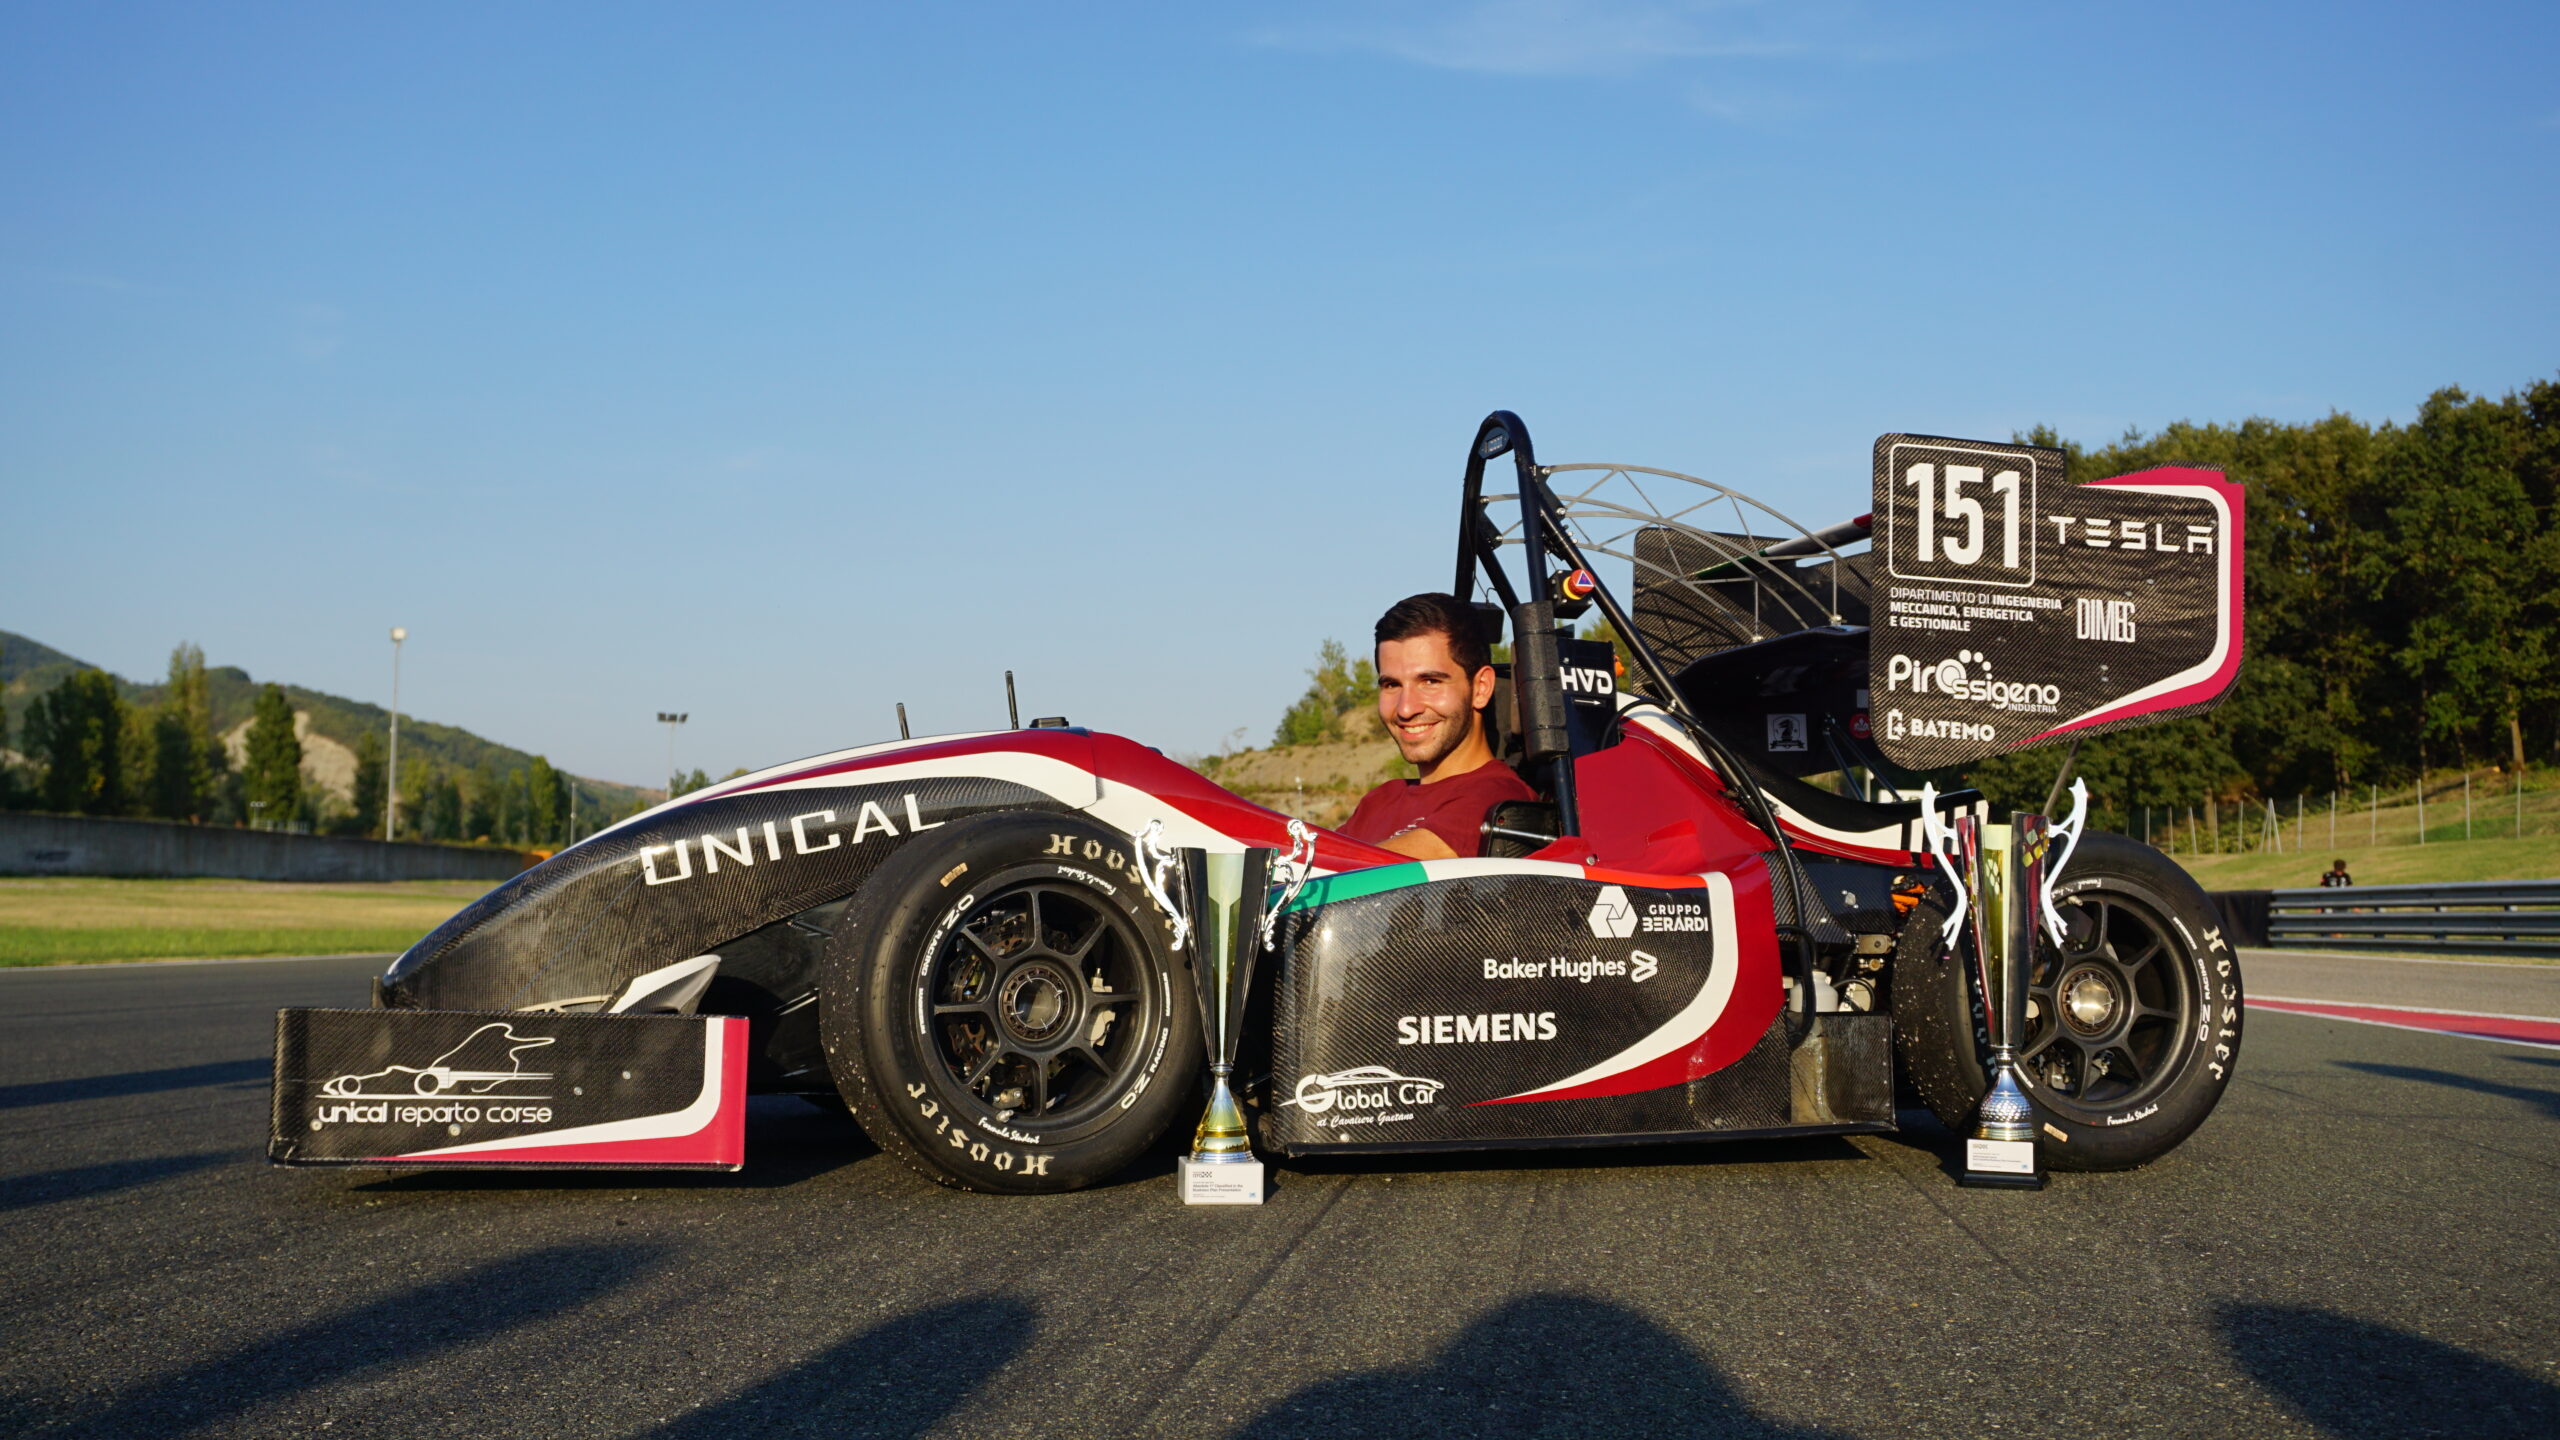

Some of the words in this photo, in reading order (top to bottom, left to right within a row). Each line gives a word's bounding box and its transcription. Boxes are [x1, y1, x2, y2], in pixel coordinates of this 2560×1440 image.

[1906, 462, 2020, 569] 151
[2048, 516, 2213, 555] TESLA
[1890, 587, 1976, 604] DIPARTIMENTO
[1978, 593, 1990, 604] DI
[1992, 594, 2062, 610] INGEGNERIA
[1890, 601, 1961, 618] MECCANICA,
[1963, 606, 2033, 621] ENERGETICA
[1890, 615, 1897, 627] E
[1900, 617, 1971, 632] GESTIONALE
[2077, 599, 2136, 643] DIMEG
[1560, 667, 1613, 695] HVD
[2008, 703, 2058, 714] INDUSTRIA
[1911, 718, 1995, 742] BATEMO
[640, 793, 945, 886] UNICAL
[1649, 904, 1701, 915] GRUPPO
[921, 929, 943, 976] RACING
[1484, 957, 1546, 979] Baker
[1550, 955, 1627, 983] Hughes
[1398, 1011, 1558, 1045] SIEMENS
[1149, 1027, 1169, 1073] RACING
[1295, 1074, 1392, 1113] Global
[1399, 1083, 1437, 1105] Car
[318, 1101, 388, 1123] unical
[394, 1102, 480, 1127] reparto
[486, 1106, 552, 1123] corse
[907, 1082, 1055, 1176] Hoosier
